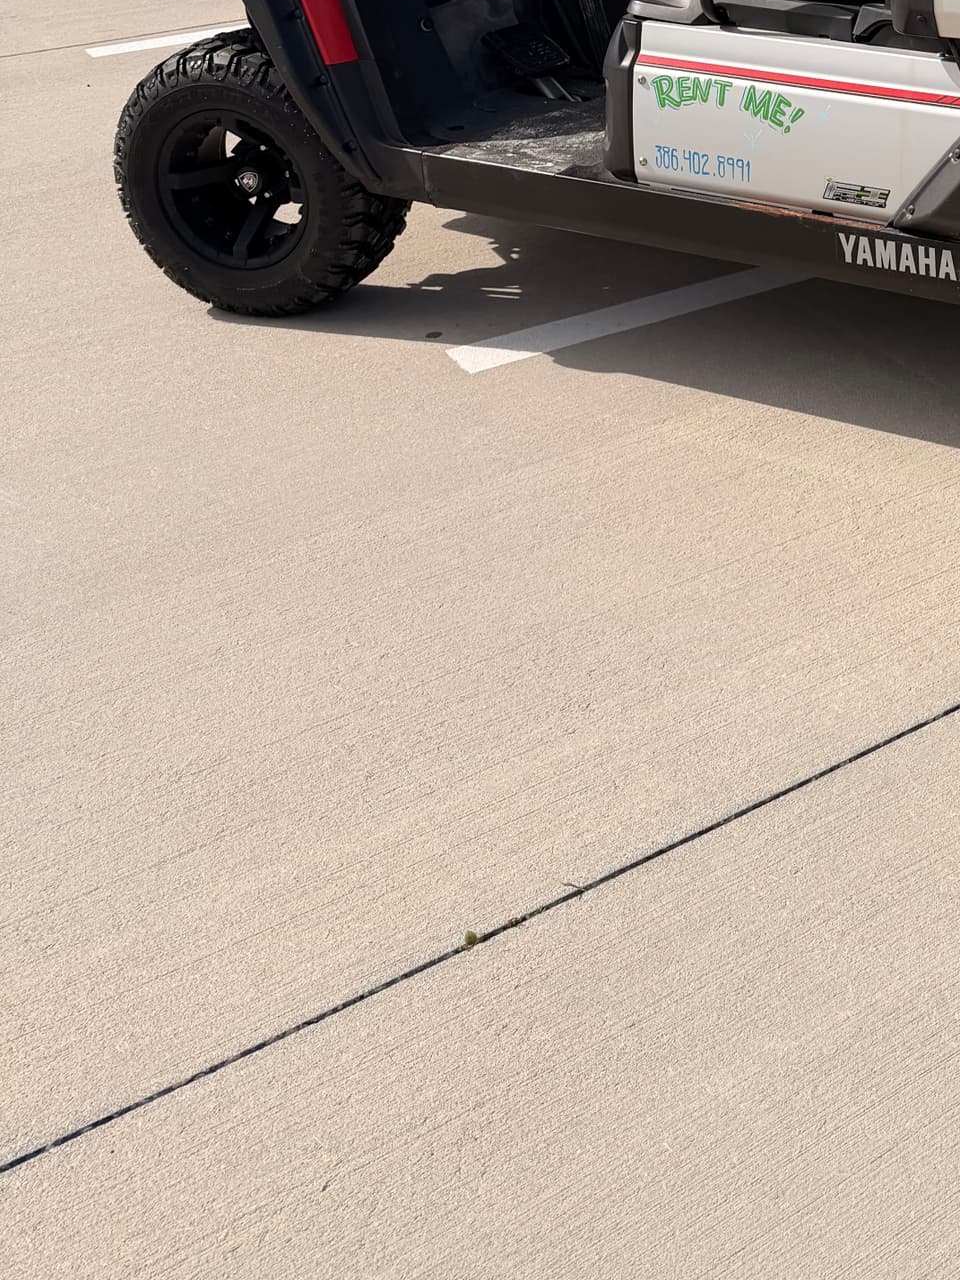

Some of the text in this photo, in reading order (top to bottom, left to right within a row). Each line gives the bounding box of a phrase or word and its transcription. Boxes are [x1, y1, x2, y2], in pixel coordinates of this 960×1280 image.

[651, 74, 805, 136] RENT ME!
[654, 144, 752, 184] 386.402.8991
[837, 232, 960, 282] YAMAHA
